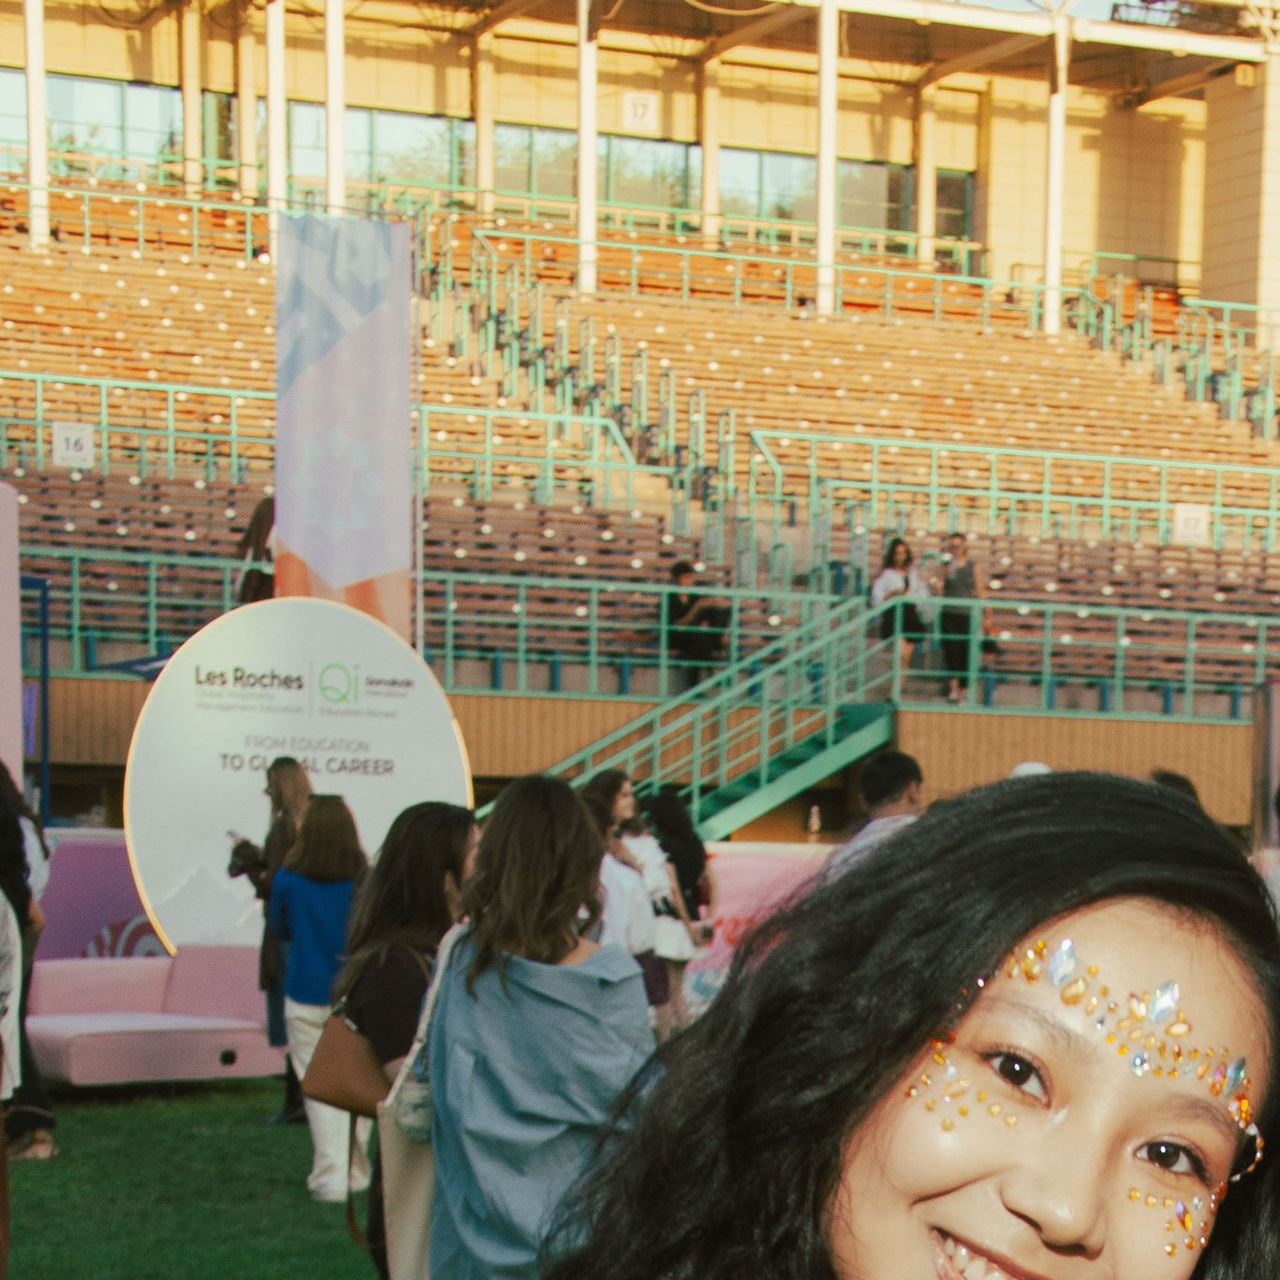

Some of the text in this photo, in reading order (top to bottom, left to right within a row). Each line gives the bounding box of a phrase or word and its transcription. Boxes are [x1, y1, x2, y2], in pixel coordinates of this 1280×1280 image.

[64, 436, 84, 453] 16
[195, 666, 304, 691] Les Roches
[244, 735, 370, 752] FROM EDUCATION
[220, 753, 244, 771] TO
[326, 757, 395, 775] CAREER
